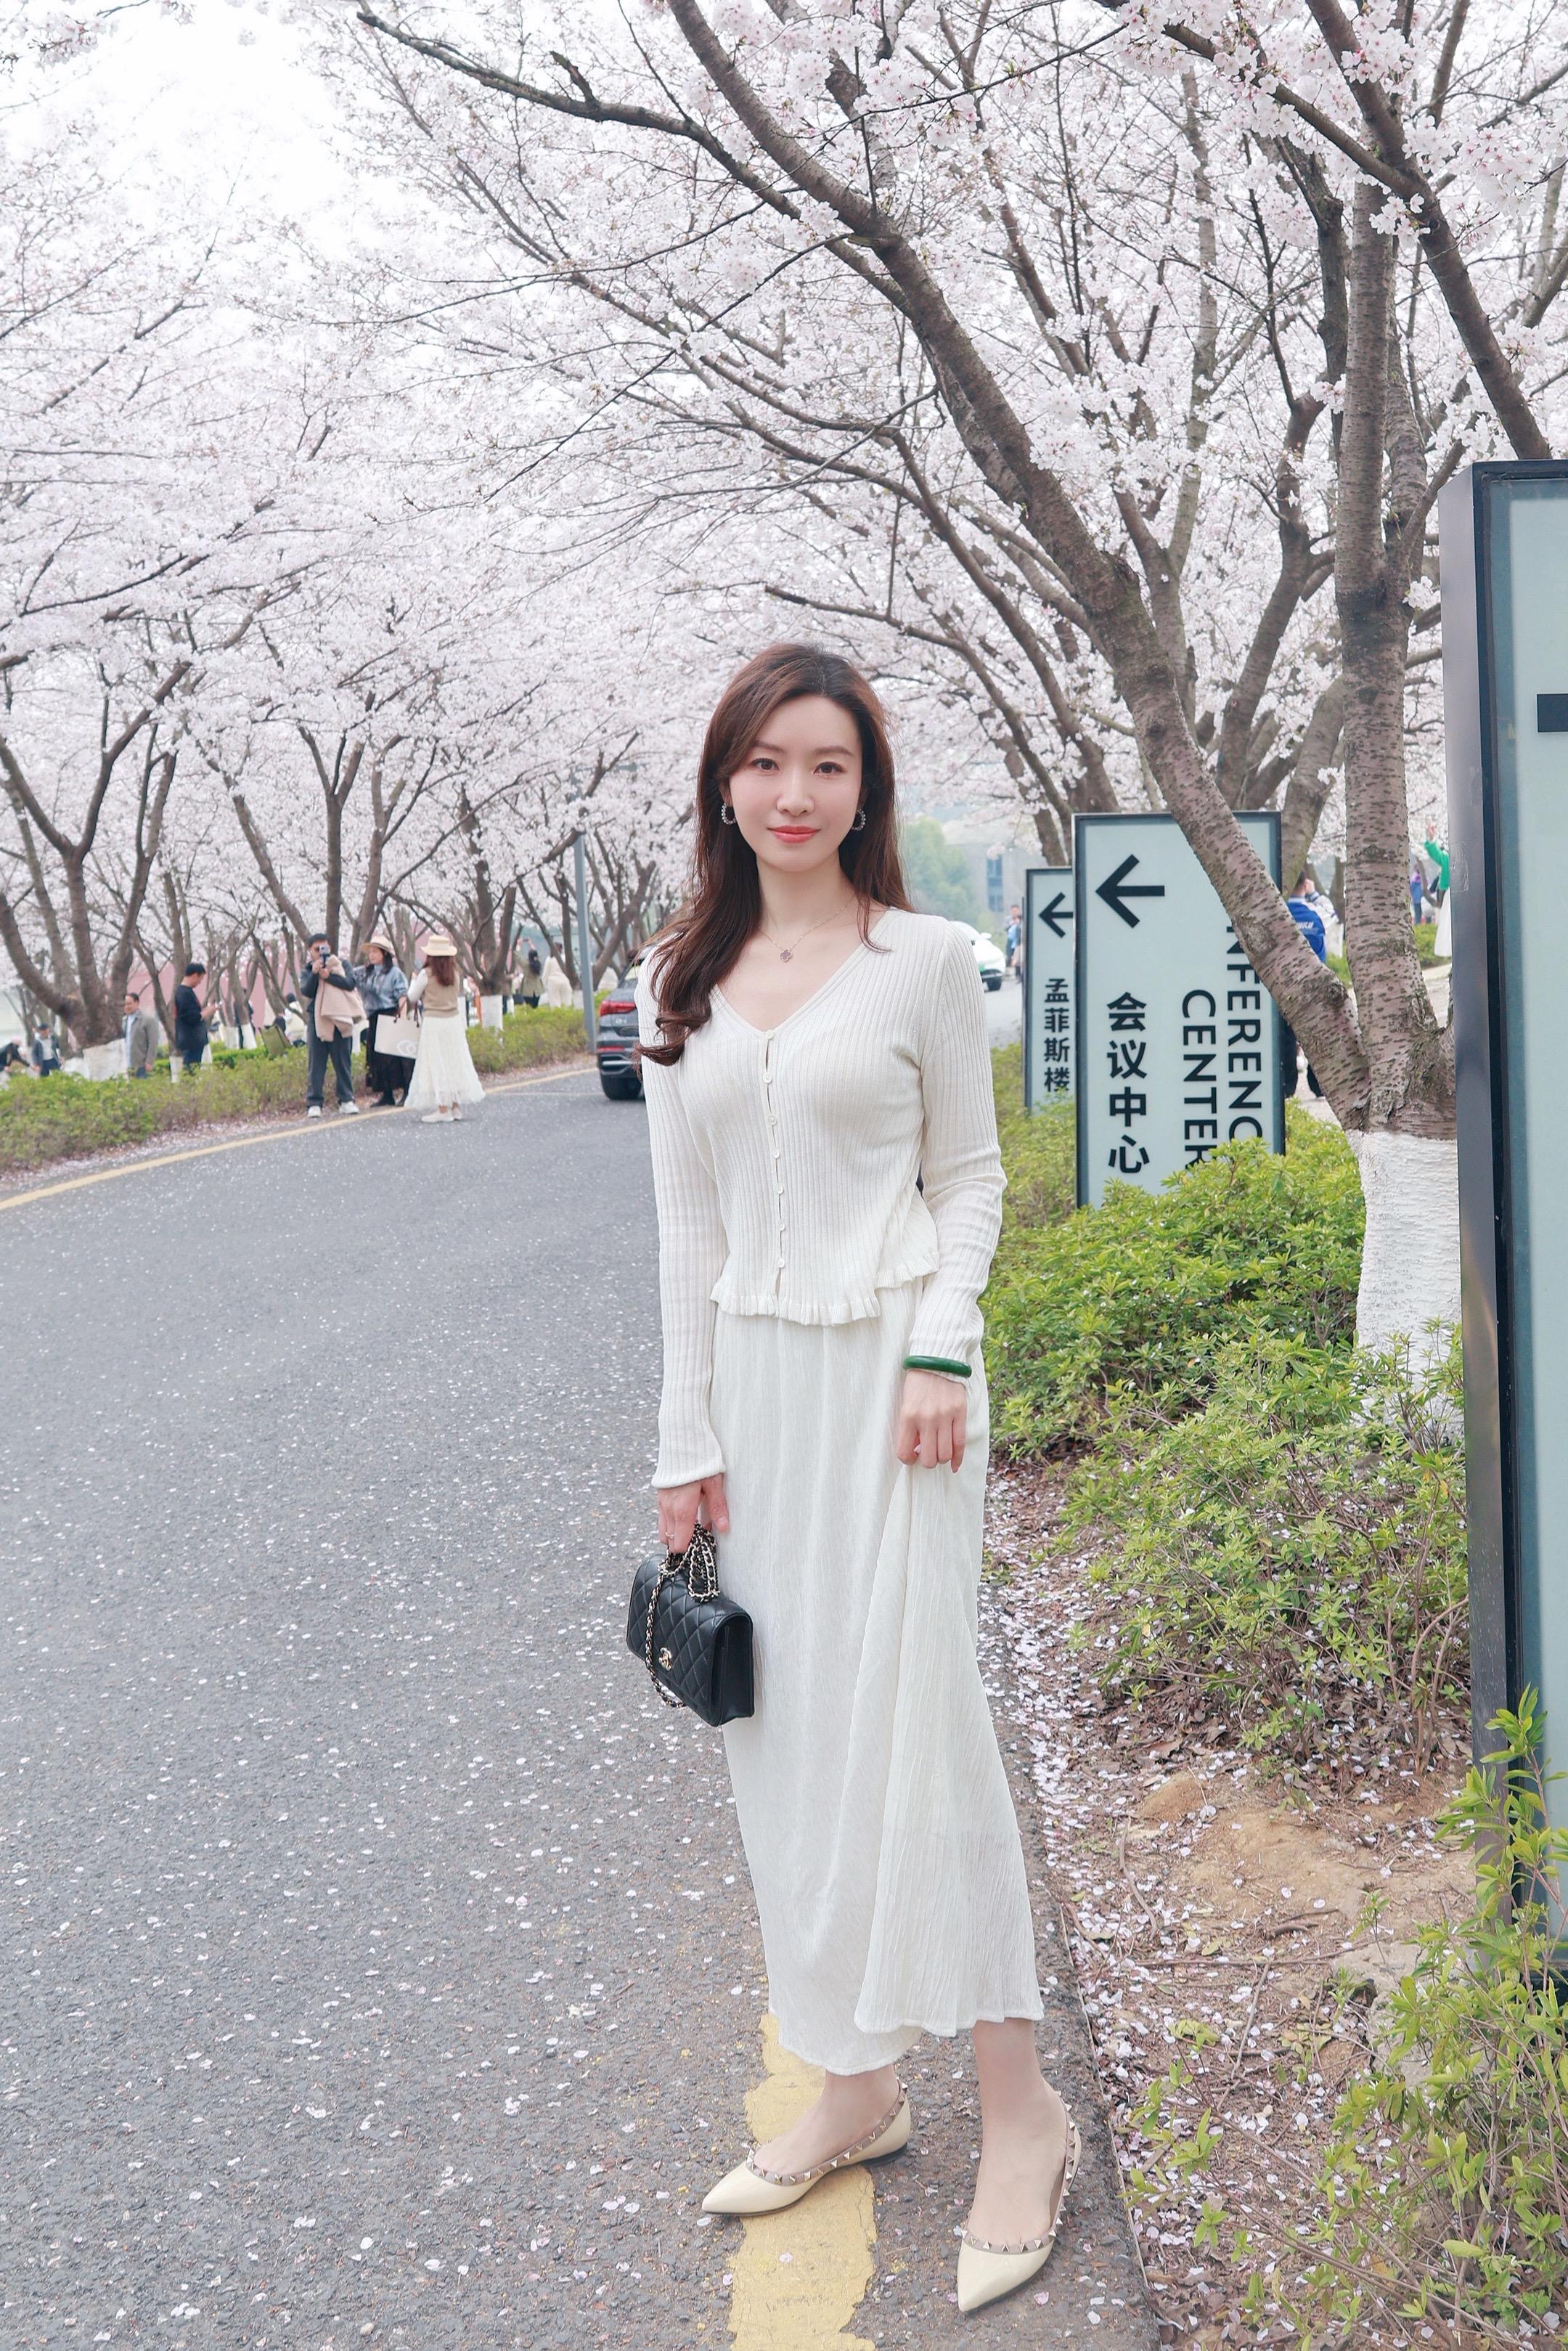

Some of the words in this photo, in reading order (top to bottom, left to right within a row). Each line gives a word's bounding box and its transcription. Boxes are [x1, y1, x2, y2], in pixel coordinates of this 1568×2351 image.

[1044, 978, 1070, 1092] 孟菲斯楼
[1106, 991, 1150, 1174] 会议中心
